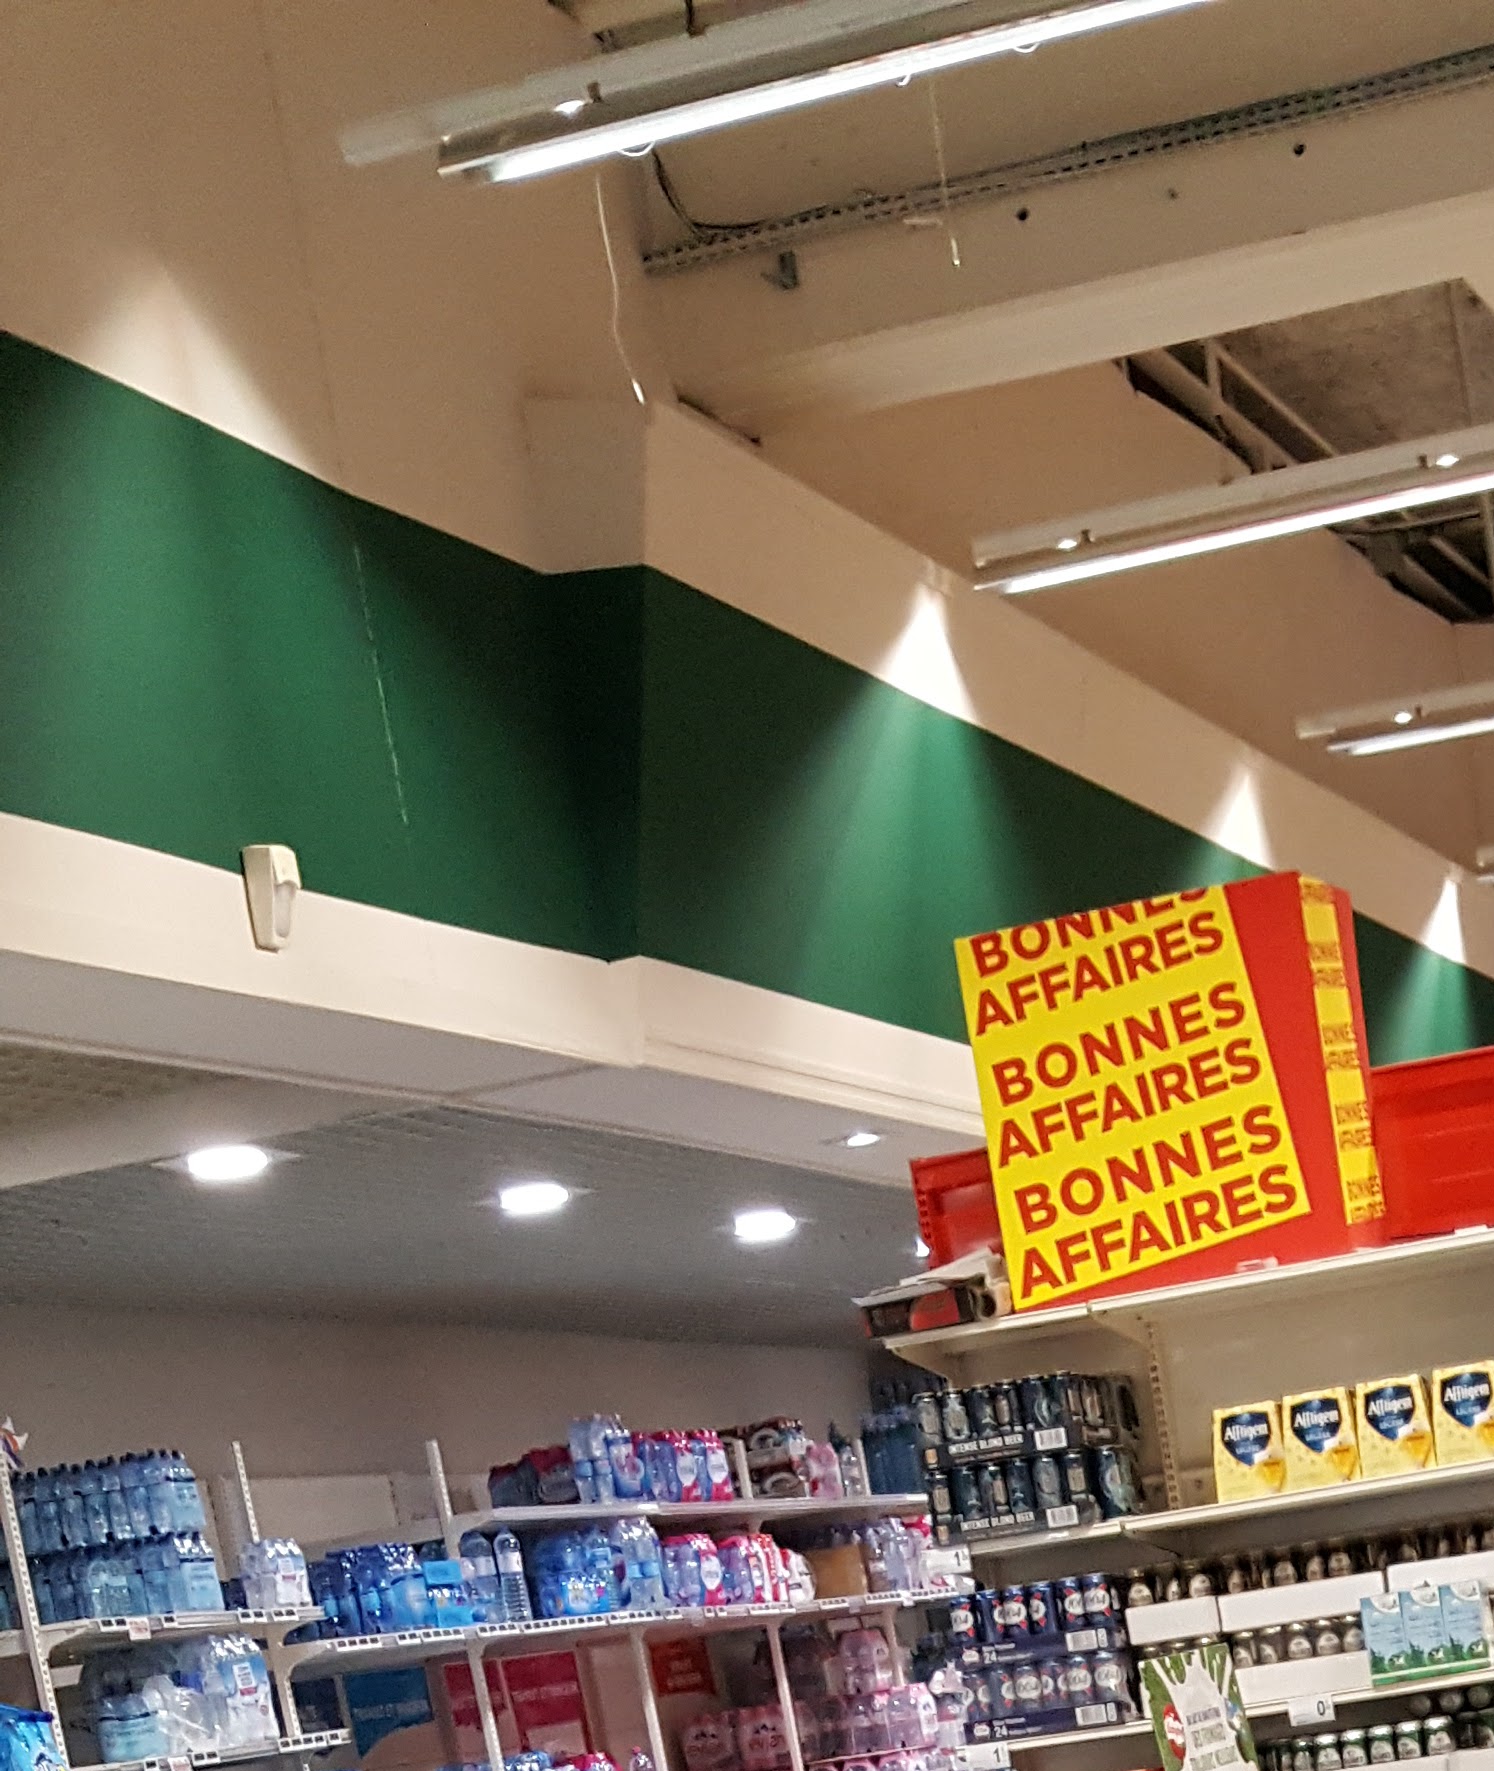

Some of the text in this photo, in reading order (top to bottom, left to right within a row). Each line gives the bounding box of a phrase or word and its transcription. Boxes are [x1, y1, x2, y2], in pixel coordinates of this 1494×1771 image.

[976, 911, 1224, 1036] AFFAIRES
[991, 981, 1245, 1107] BONNES
[999, 1037, 1261, 1168] AFFAIRES
[1014, 1104, 1282, 1235] BONNES
[1021, 1163, 1297, 1299] AFFAIRES
[1293, 1408, 1340, 1429] Affligem
[1444, 1382, 1491, 1404] Affligem
[1224, 1422, 1269, 1442] Affligem
[983, 1651, 997, 1664] 24
[994, 1725, 1008, 1738] 24
